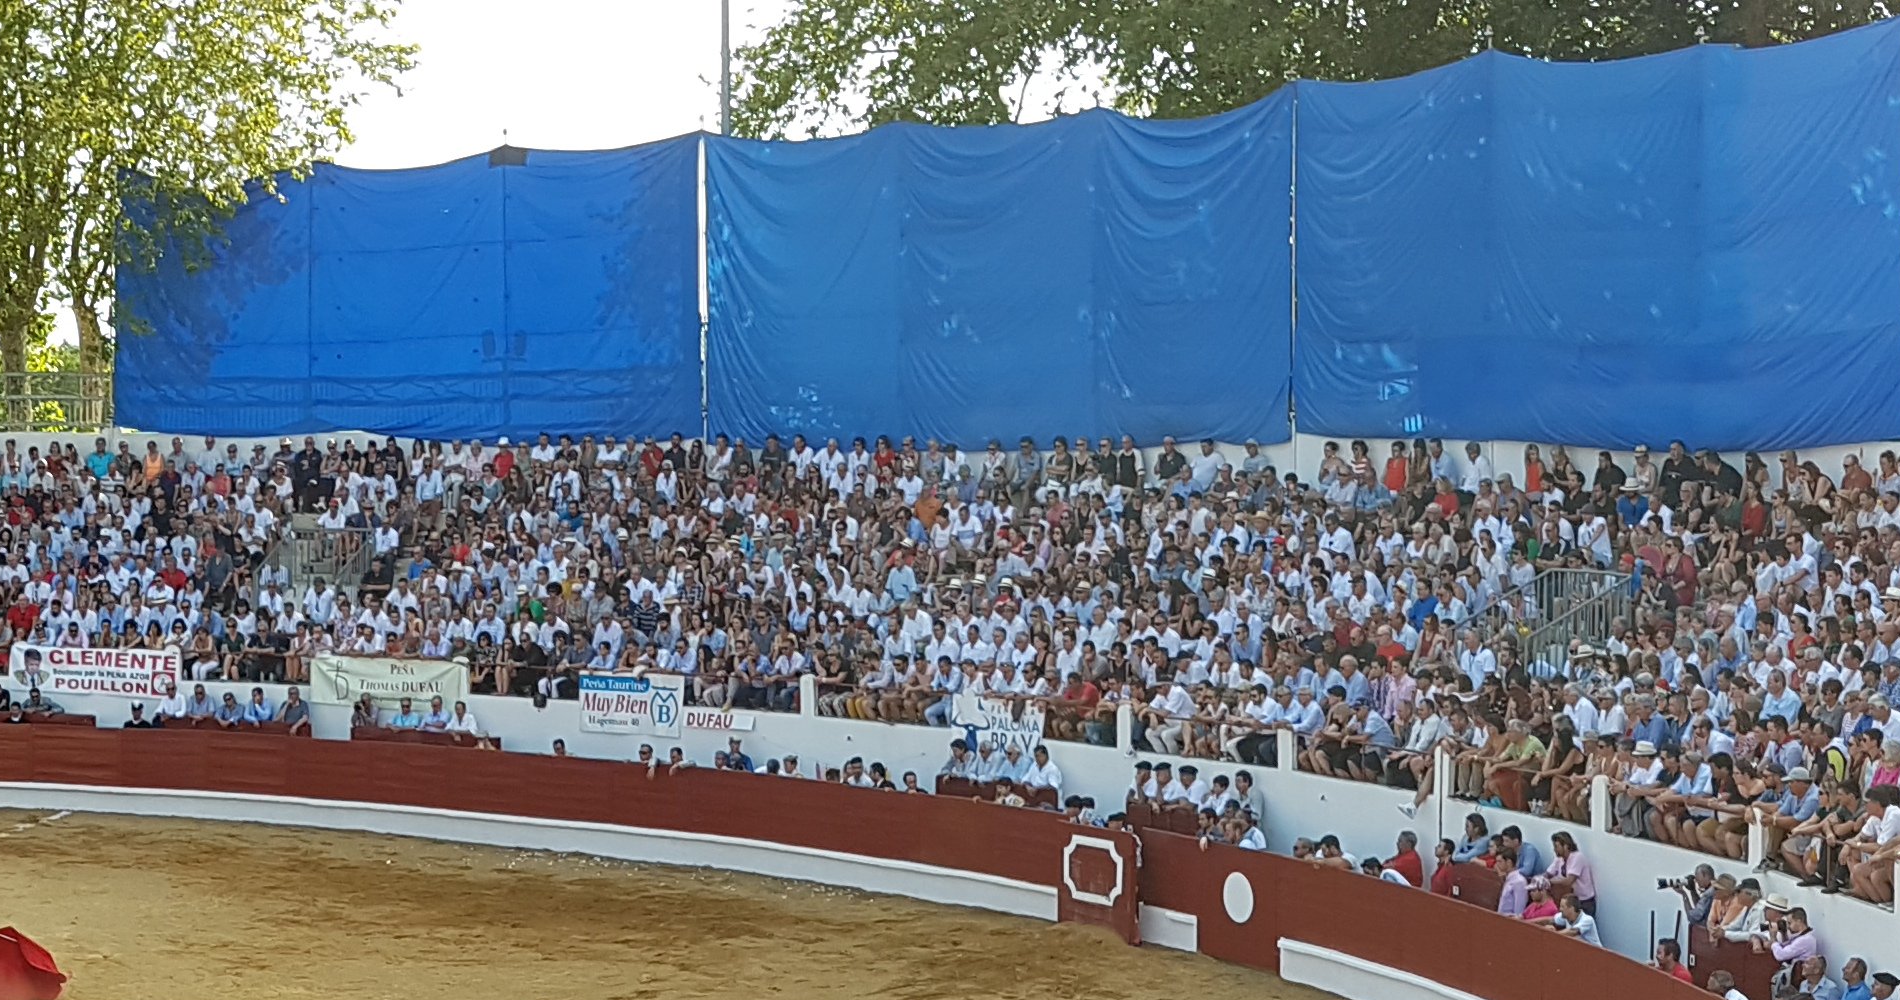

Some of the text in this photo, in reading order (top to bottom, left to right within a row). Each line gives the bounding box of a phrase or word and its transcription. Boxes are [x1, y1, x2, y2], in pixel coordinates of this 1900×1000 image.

[106, 670, 126, 679] PEÑA
[55, 677, 148, 694] POUILLON
[401, 681, 444, 693] DUFAU
[583, 678, 647, 691] Peña Taurine
[582, 692, 648, 717] Muy Bien
[631, 718, 640, 727] 40
[686, 712, 734, 730] DUFAU
[991, 716, 1040, 733] PALOMA
